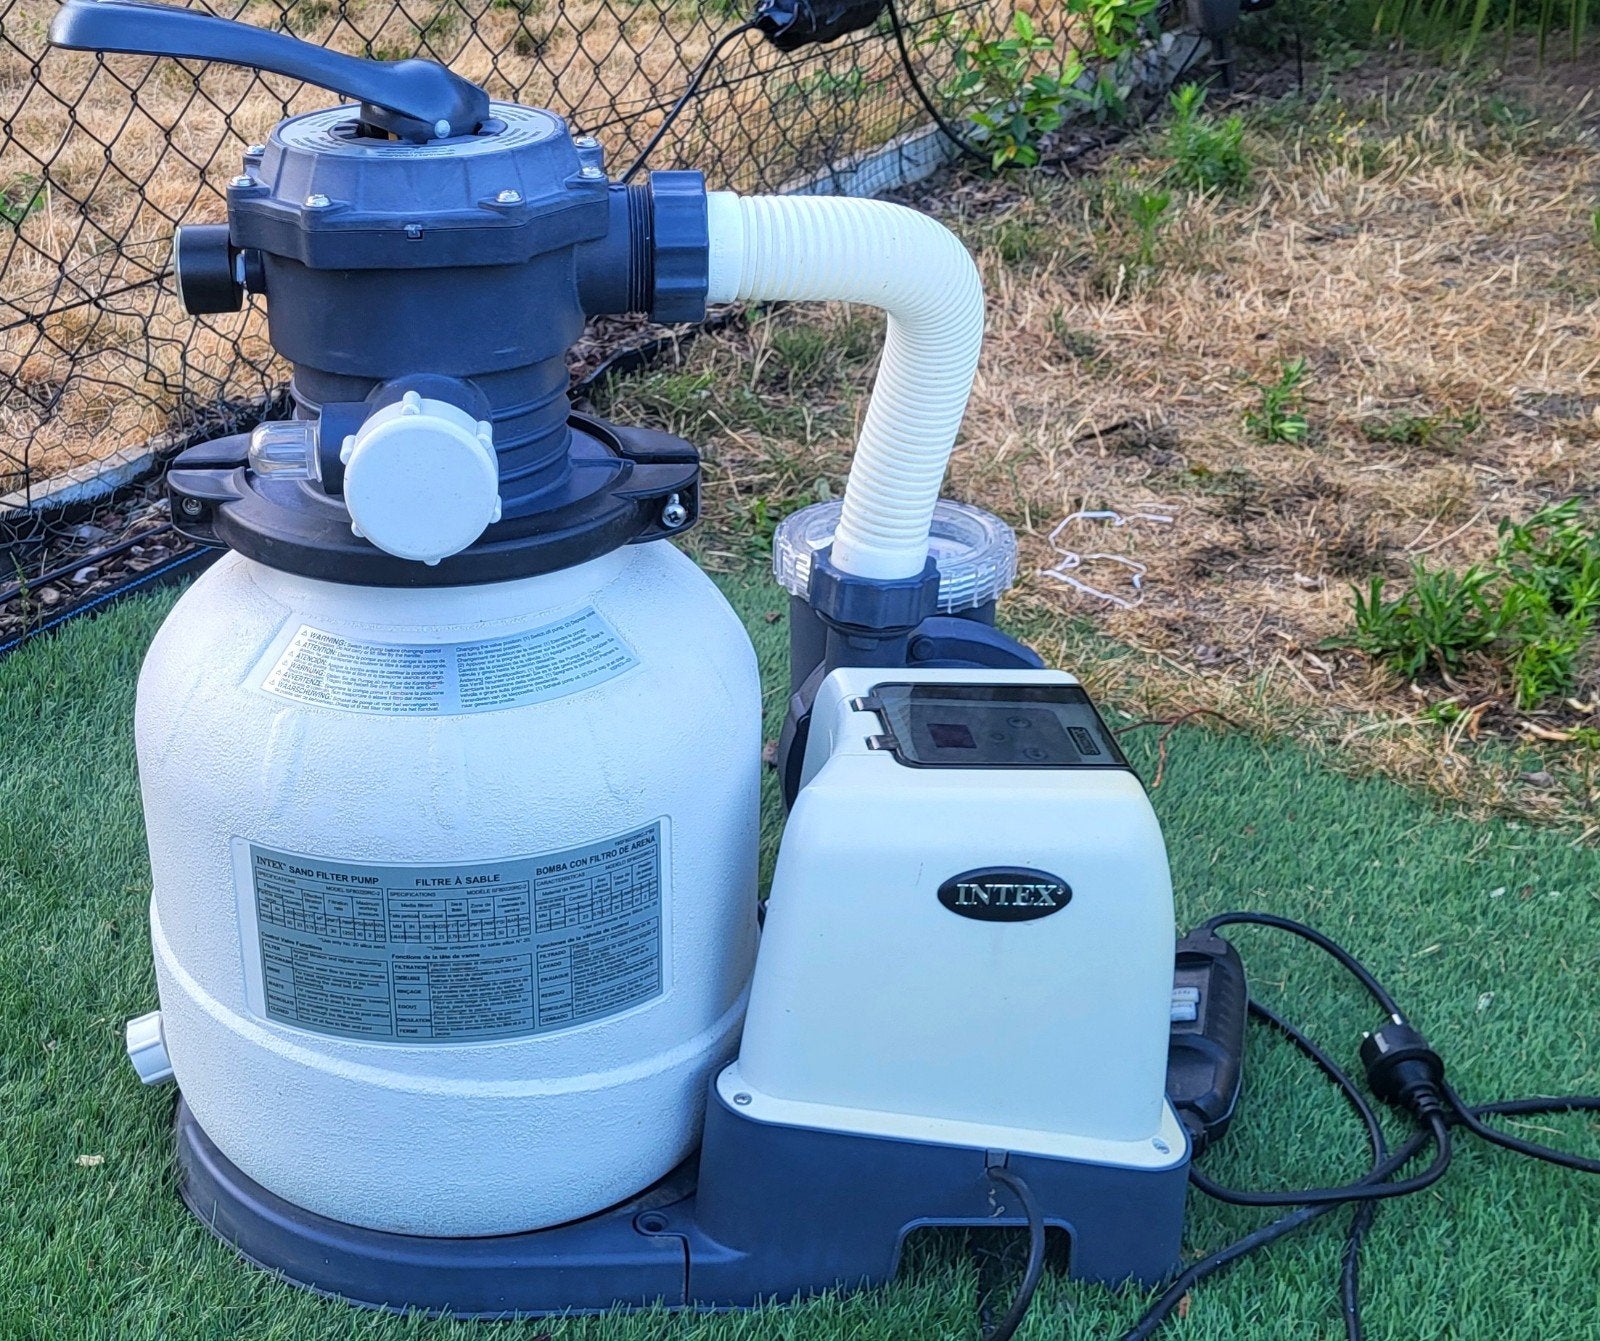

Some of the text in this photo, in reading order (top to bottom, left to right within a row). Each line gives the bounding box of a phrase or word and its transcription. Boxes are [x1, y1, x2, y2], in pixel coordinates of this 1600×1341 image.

[310, 632, 347, 646] WARNING:
[536, 862, 567, 876] BOMBA
[570, 859, 587, 868] CON
[590, 849, 617, 864] FILTRO
[620, 847, 629, 855] DE
[631, 835, 655, 850] ARENA
[289, 866, 313, 877] SAND
[317, 871, 348, 882] FILTER
[351, 875, 379, 885] PUMP
[416, 874, 500, 886] FILTRE À SABLE
[955, 884, 1057, 906] INTEX
[261, 932, 280, 940] Control
[296, 941, 322, 951] Functions
